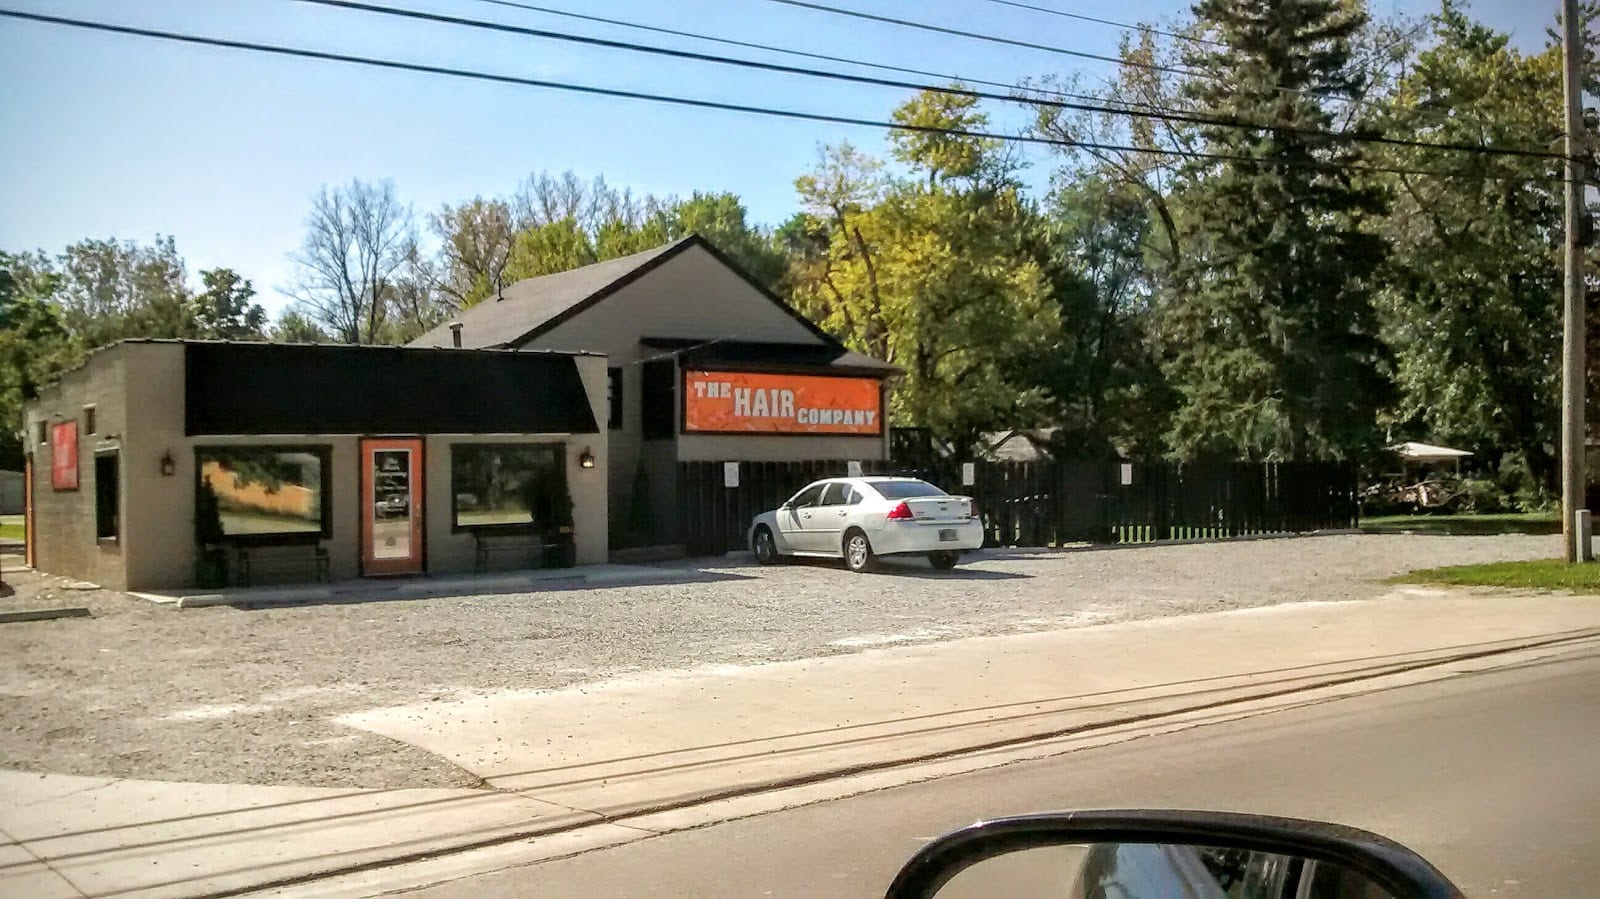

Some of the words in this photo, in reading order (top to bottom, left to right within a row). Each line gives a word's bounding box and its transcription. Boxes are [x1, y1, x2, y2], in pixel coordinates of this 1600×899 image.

[694, 381, 731, 399] THE
[734, 387, 795, 417] HAIR
[797, 407, 876, 426] COMPANY
